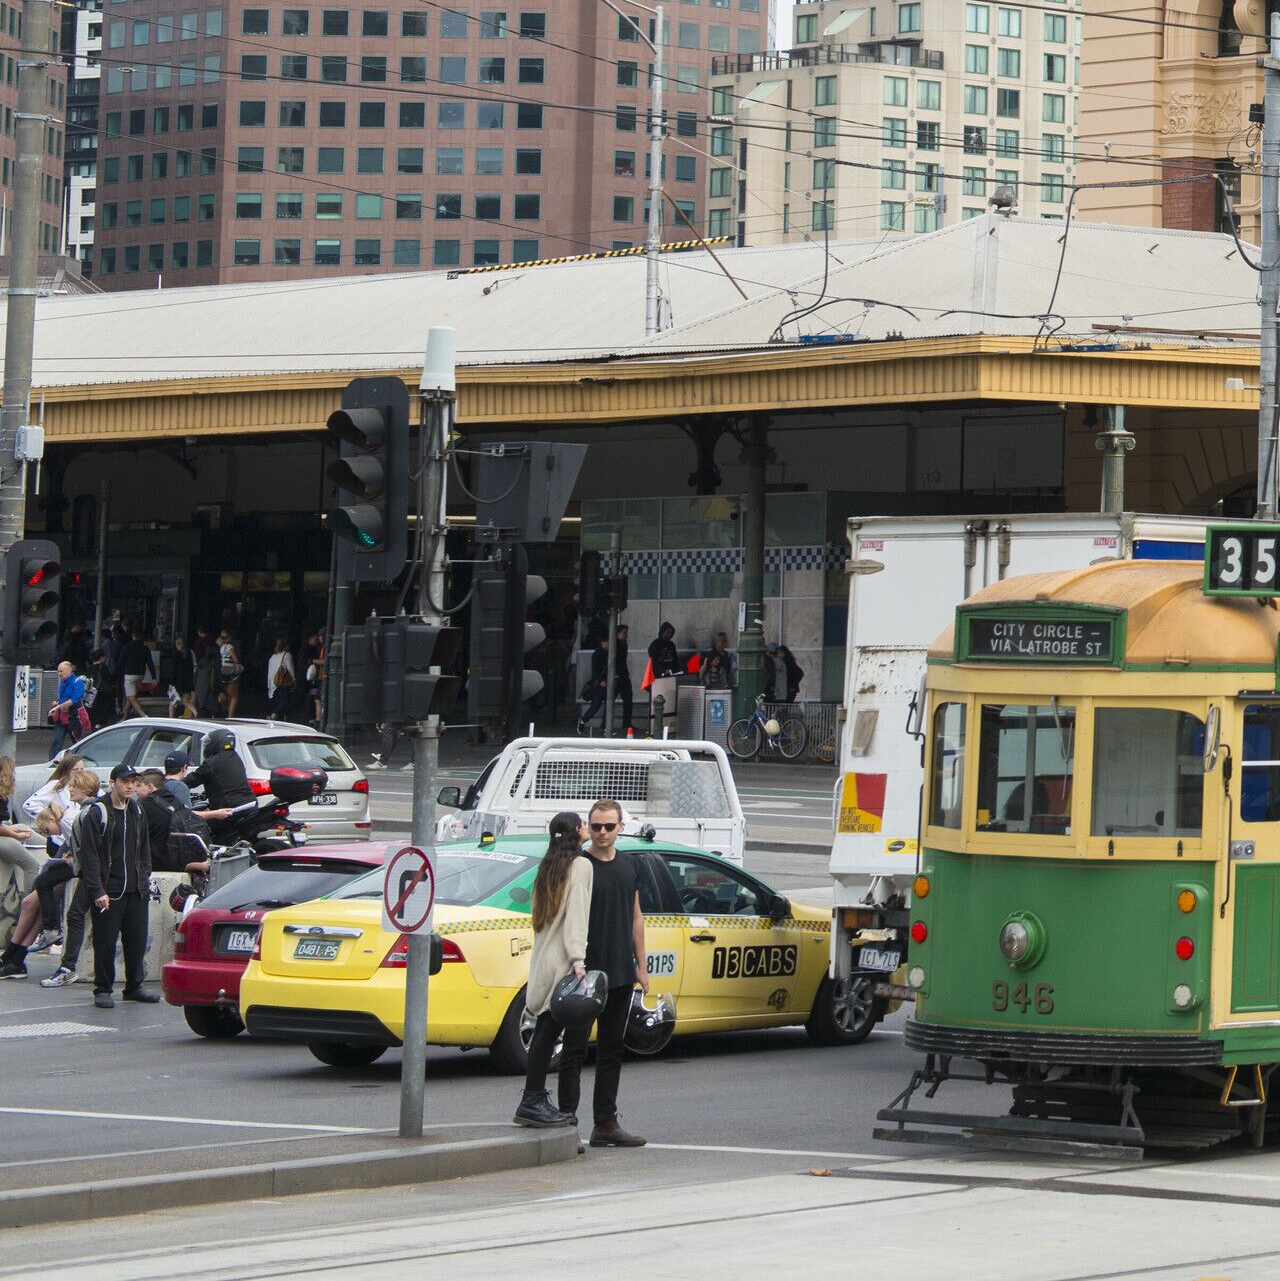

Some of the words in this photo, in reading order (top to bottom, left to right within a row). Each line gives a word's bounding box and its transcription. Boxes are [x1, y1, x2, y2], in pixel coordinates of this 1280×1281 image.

[993, 623, 1025, 636] CITY
[1033, 624, 1083, 638] CIRCLE
[990, 638, 1012, 652] VIA
[1019, 640, 1078, 654] LATROBE
[1086, 642, 1102, 655] ST
[298, 944, 320, 956] 0481
[324, 946, 338, 956] PS
[646, 954, 675, 974] 81PS
[715, 946, 797, 977] 13CABS
[882, 951, 899, 967] 7LS
[991, 979, 1055, 1015] 946
